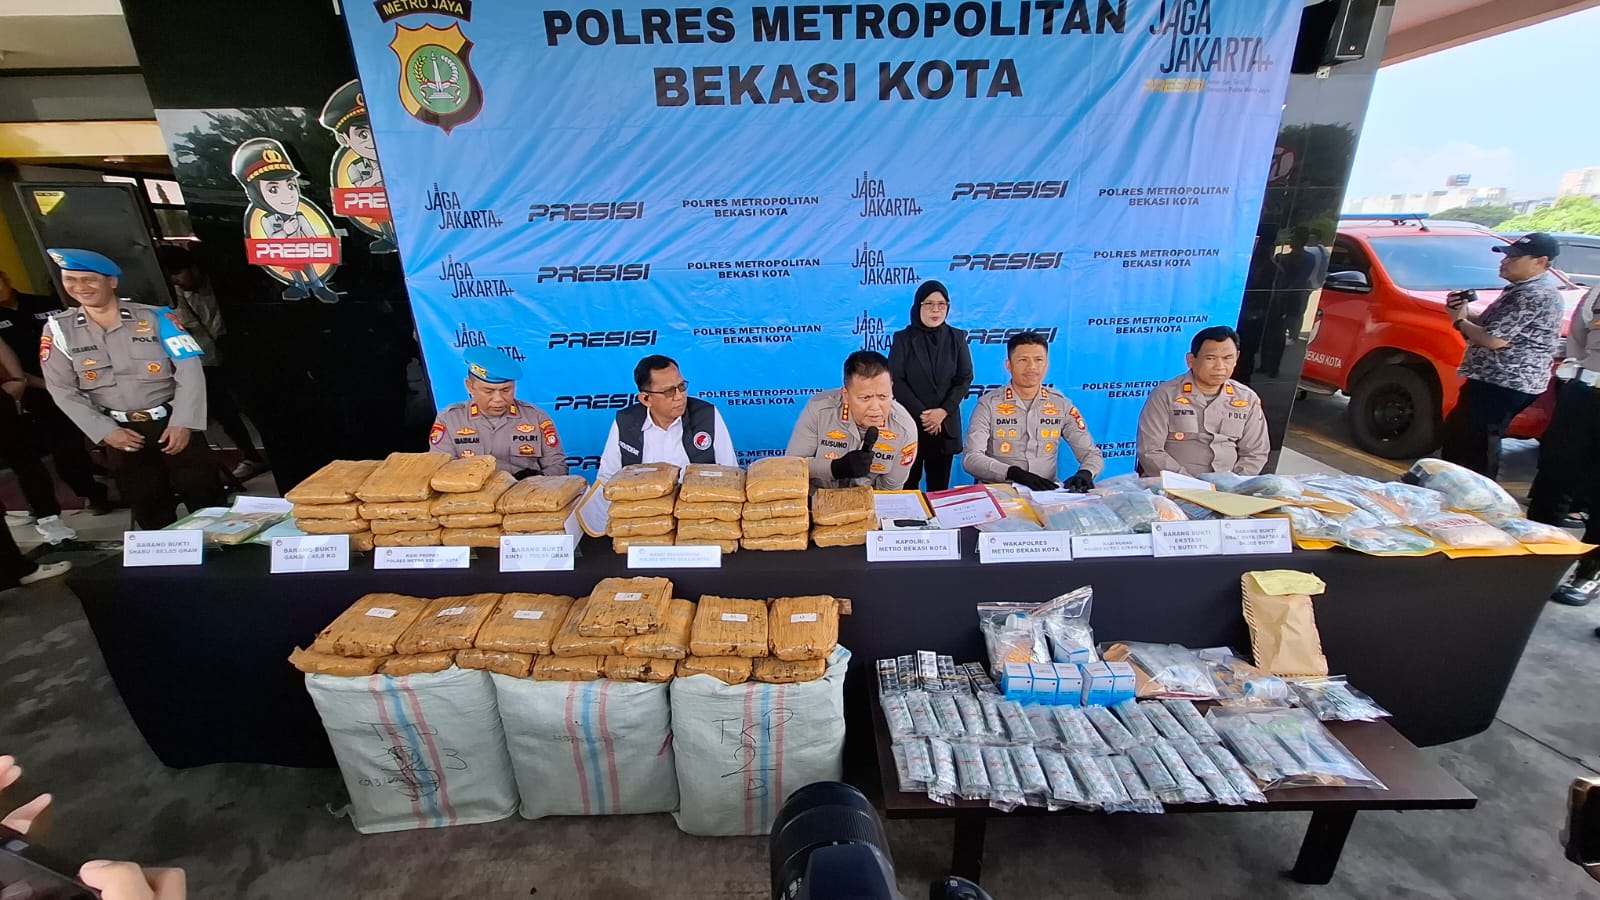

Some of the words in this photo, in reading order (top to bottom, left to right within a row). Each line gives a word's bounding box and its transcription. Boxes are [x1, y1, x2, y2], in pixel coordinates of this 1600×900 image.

[382, 0, 428, 16] METRO
[431, 0, 464, 15] JAYA
[543, 6, 736, 46] POLRES
[751, 0, 1127, 43] METROPOLITAN
[1149, 0, 1212, 36] JAGA
[653, 62, 856, 107] BEKASI
[878, 58, 1024, 100] KOTA
[851, 173, 886, 199] JAGA
[951, 180, 1069, 201] PRESISI
[1098, 187, 1143, 197] POLRES
[1146, 186, 1230, 196] METROPOLITAN
[344, 191, 389, 209] PRE
[424, 186, 462, 212] JAGA
[682, 198, 729, 208] POLRES
[731, 196, 819, 207] METROPOLITAN
[1128, 197, 1170, 207] BEKASI
[1172, 197, 1200, 206] KOTA
[527, 201, 645, 222] PRESISI
[714, 208, 756, 218] BEKASI
[759, 207, 789, 217] KOTA
[255, 242, 333, 259] PRESISI
[851, 245, 885, 269] JAGA
[1093, 250, 1137, 259] POLRES
[1140, 248, 1220, 258] METROPOLITAN
[439, 257, 474, 281] JAGA
[687, 261, 732, 270] POLRES
[734, 258, 820, 268] METROPOLITAN
[948, 251, 1064, 272] PRESISI
[1122, 259, 1162, 268] BEKASI
[1164, 259, 1192, 267] KOTA
[537, 263, 651, 284] PRESISI
[718, 270, 759, 279] BEKASI
[762, 269, 791, 278] KOTA
[852, 314, 885, 335] JAGA
[1088, 317, 1130, 326] POLRES
[1132, 315, 1209, 325] METROPOLITAN
[453, 326, 487, 348] JAGA
[693, 327, 736, 336] POLRES
[739, 325, 822, 334] METROPOLITAN
[1115, 326, 1153, 334] BEKASI
[1156, 325, 1182, 333] KOTA
[548, 329, 658, 350] PRESISI
[723, 335, 763, 344] BEKASI
[765, 335, 793, 343] KOTA
[1082, 381, 1122, 390] POLRES
[699, 390, 740, 398] POLRES
[728, 398, 766, 406] BEKASI
[768, 397, 795, 405] KOTA
[1108, 390, 1145, 398] BEKASI
[820, 439, 848, 449] KUSUMO
[1102, 450, 1135, 458] BEKASI
[711, 707, 794, 745] TKP
[721, 745, 777, 779] 2
